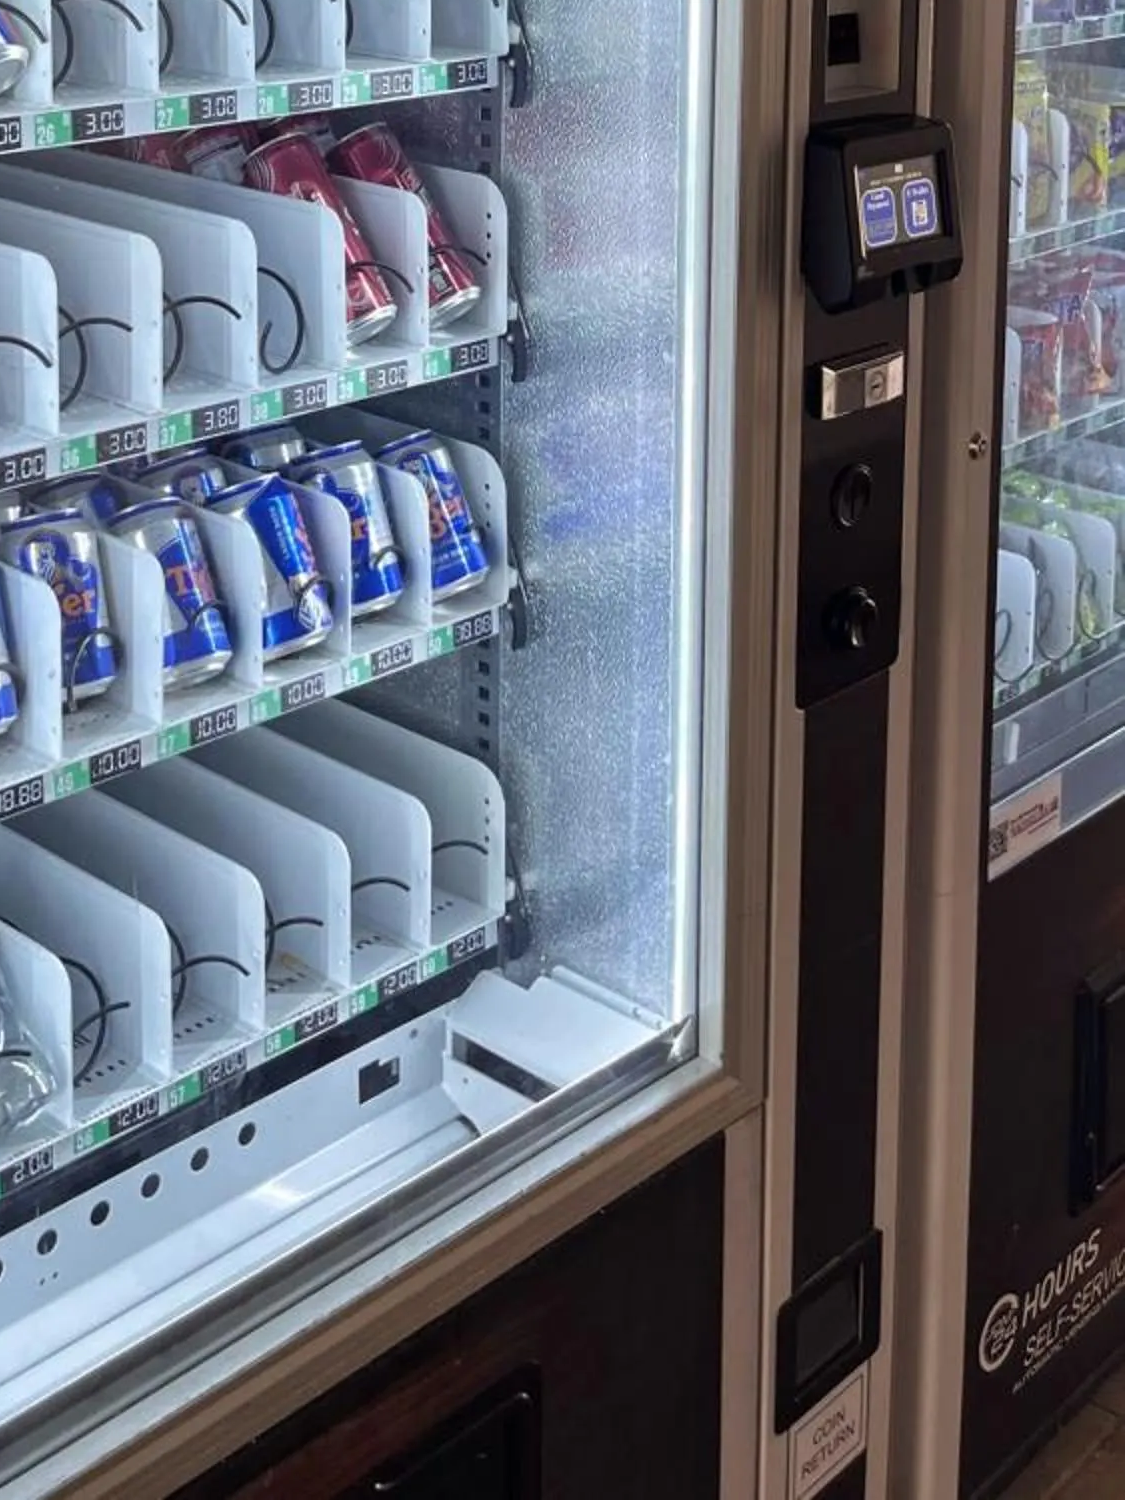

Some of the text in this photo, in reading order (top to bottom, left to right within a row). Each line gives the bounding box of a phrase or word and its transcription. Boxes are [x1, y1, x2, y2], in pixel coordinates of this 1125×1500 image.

[36, 110, 124, 146] 26 3.00
[157, 110, 175, 129] 27
[1023, 1227, 1102, 1328] HOURS
[811, 1405, 847, 1447] COIN
[800, 1419, 857, 1480] RETURN
